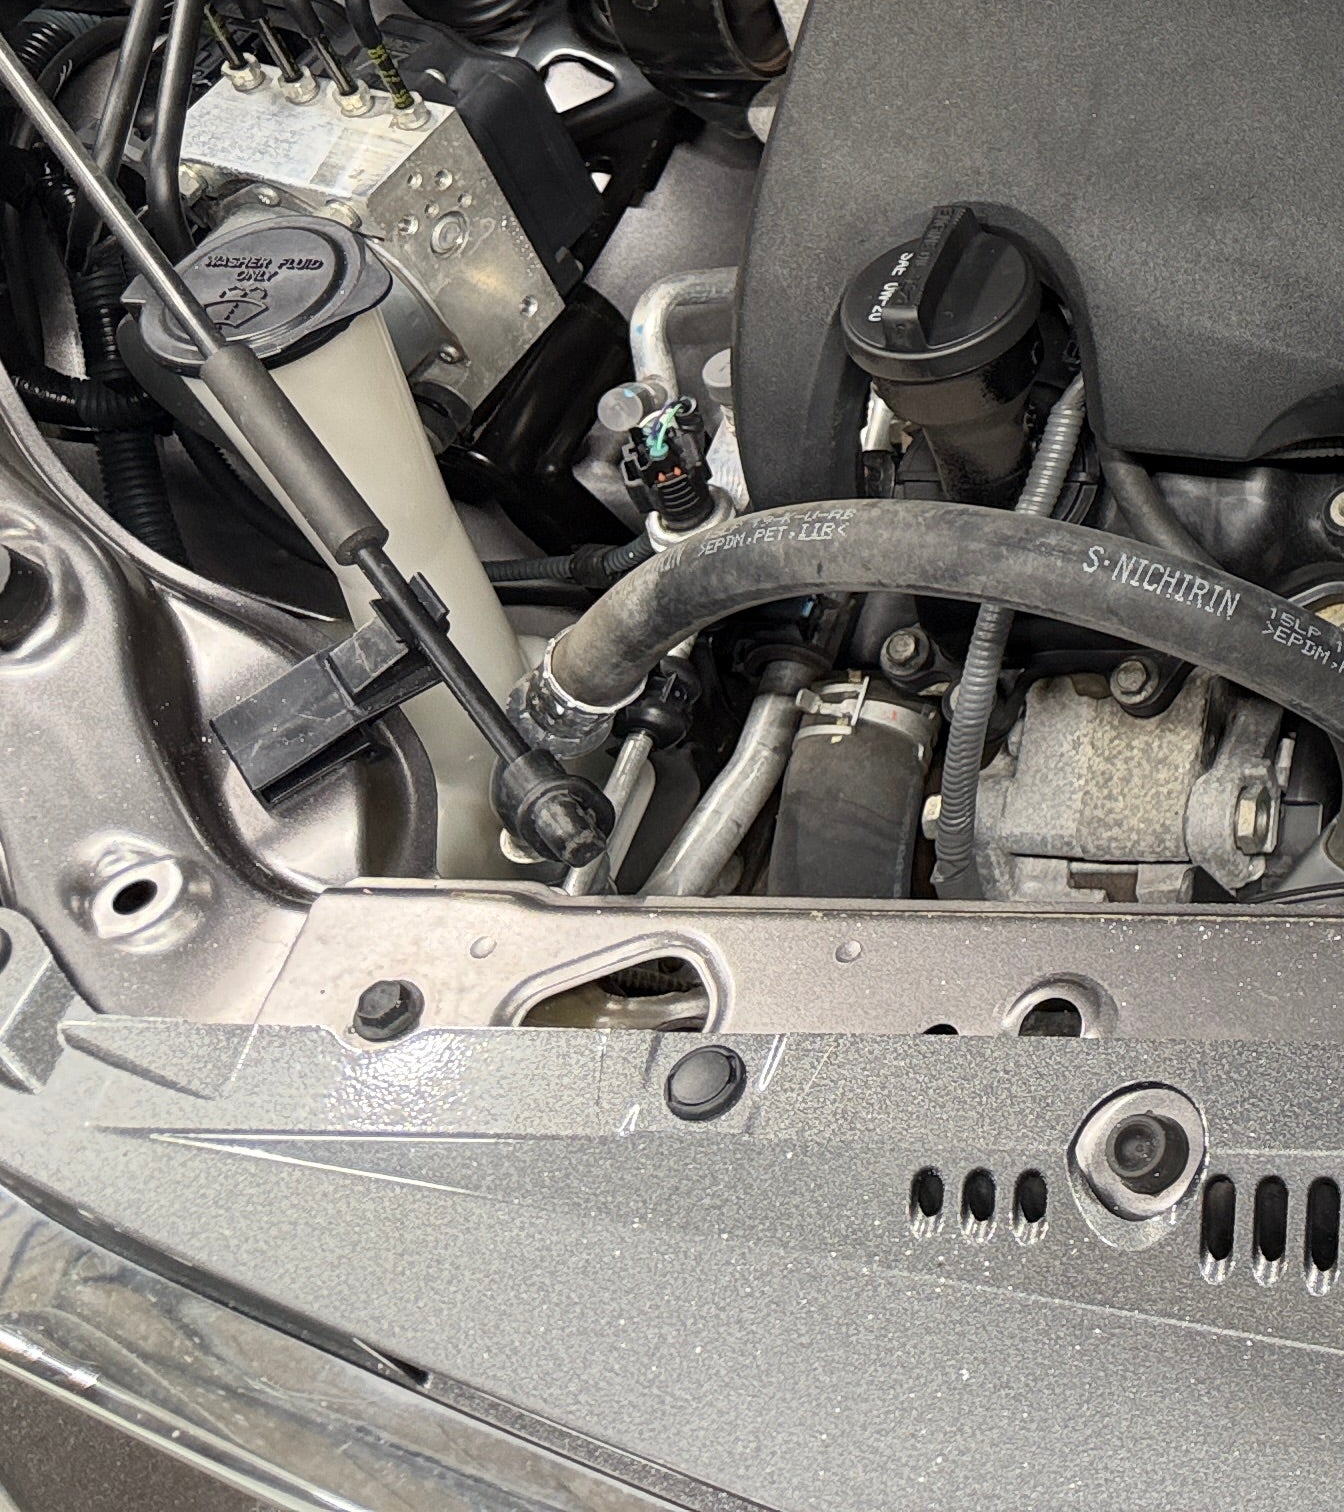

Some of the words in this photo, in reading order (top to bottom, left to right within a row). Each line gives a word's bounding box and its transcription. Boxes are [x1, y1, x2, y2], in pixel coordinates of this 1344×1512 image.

[205, 255, 273, 270] WASHER
[277, 258, 324, 271] FLUID
[235, 270, 283, 284] ONLY
